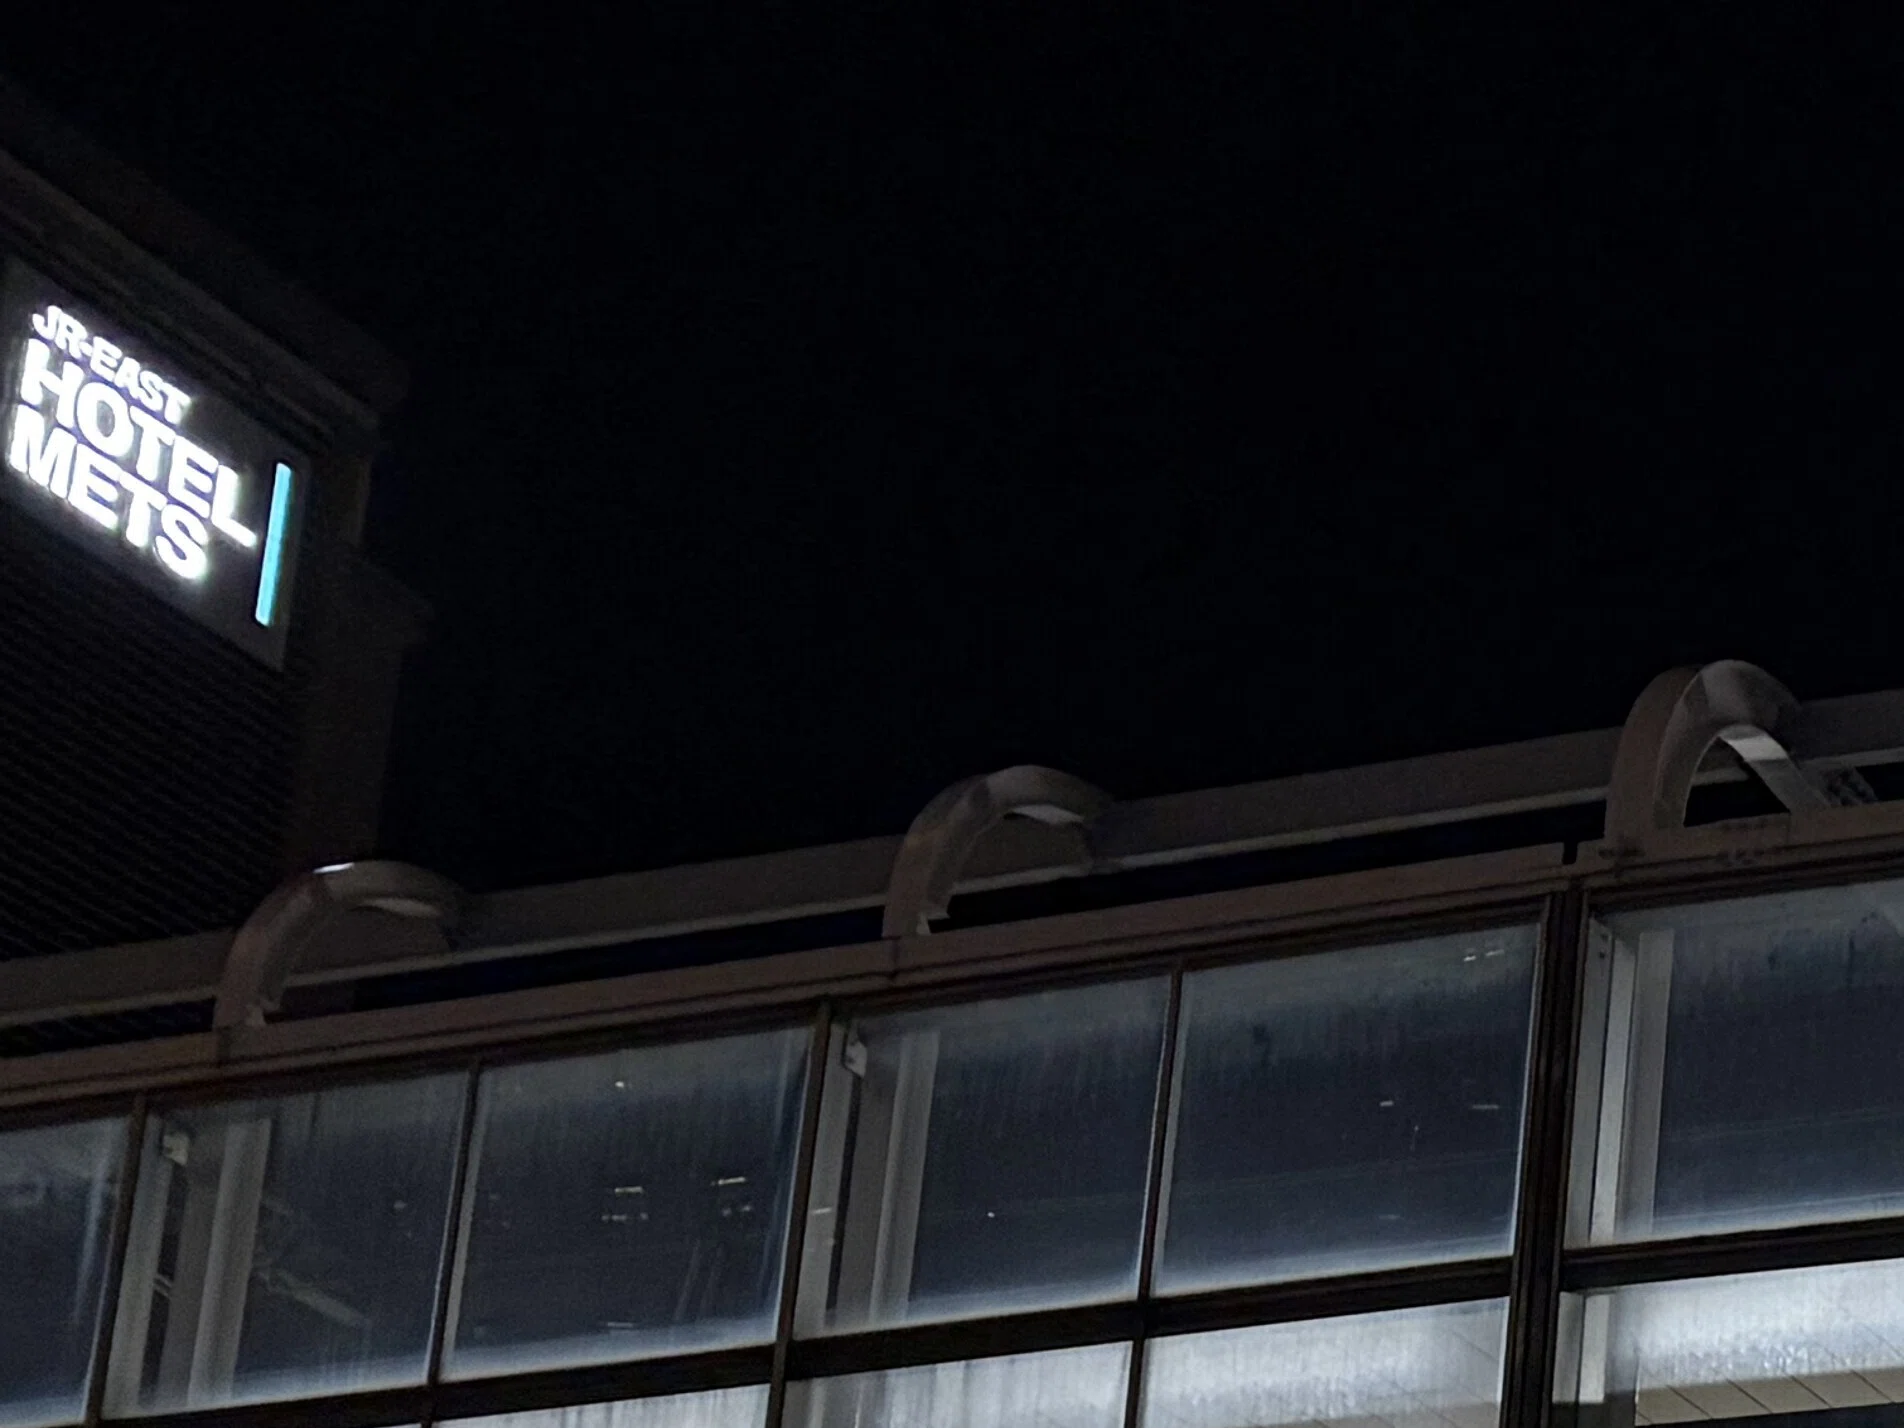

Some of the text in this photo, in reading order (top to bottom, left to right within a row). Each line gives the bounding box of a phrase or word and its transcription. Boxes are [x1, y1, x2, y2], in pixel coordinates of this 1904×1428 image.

[20, 338, 257, 548] HOTEL
[32, 304, 192, 424] JR-EAST
[9, 404, 208, 580] METS
